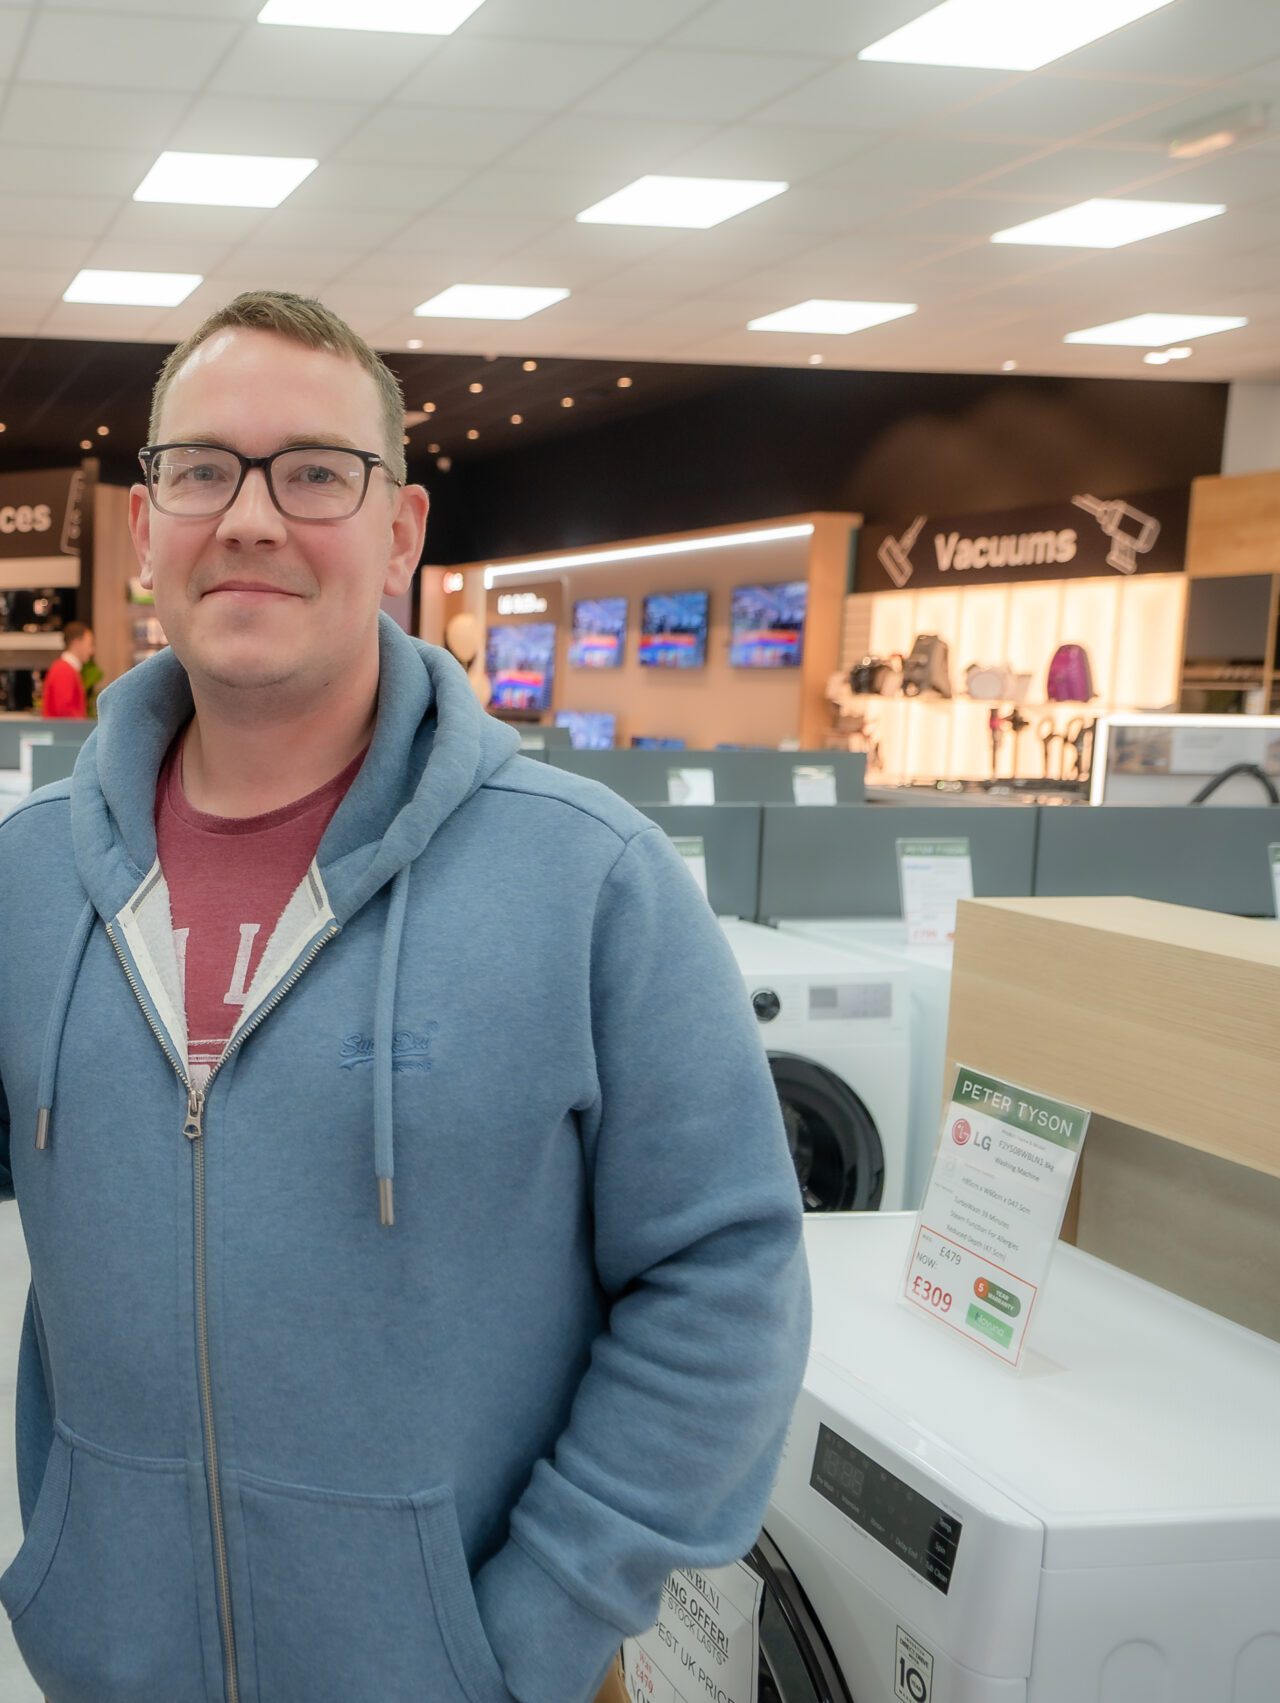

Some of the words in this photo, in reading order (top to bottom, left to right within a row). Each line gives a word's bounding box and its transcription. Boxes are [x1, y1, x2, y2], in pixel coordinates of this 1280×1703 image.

[934, 528, 1077, 571] Vacuums
[962, 1080, 1012, 1112] PETER
[1017, 1102, 1073, 1137] TYSON
[973, 1131, 992, 1151] LG
[995, 1157, 1016, 1173] Washing
[1017, 1167, 1040, 1181] Machine
[939, 1246, 961, 1265] £479
[912, 1275, 952, 1312] £309
[978, 1283, 985, 1293] 5
[996, 1290, 1010, 1301] YEAR
[987, 1292, 1014, 1311] WARRANTY
[935, 1541, 946, 1555] Spin
[934, 1568, 948, 1584] Clean
[667, 1597, 695, 1635] STOCK
[690, 1599, 729, 1654] OFFER!
[680, 1647, 696, 1676] UK
